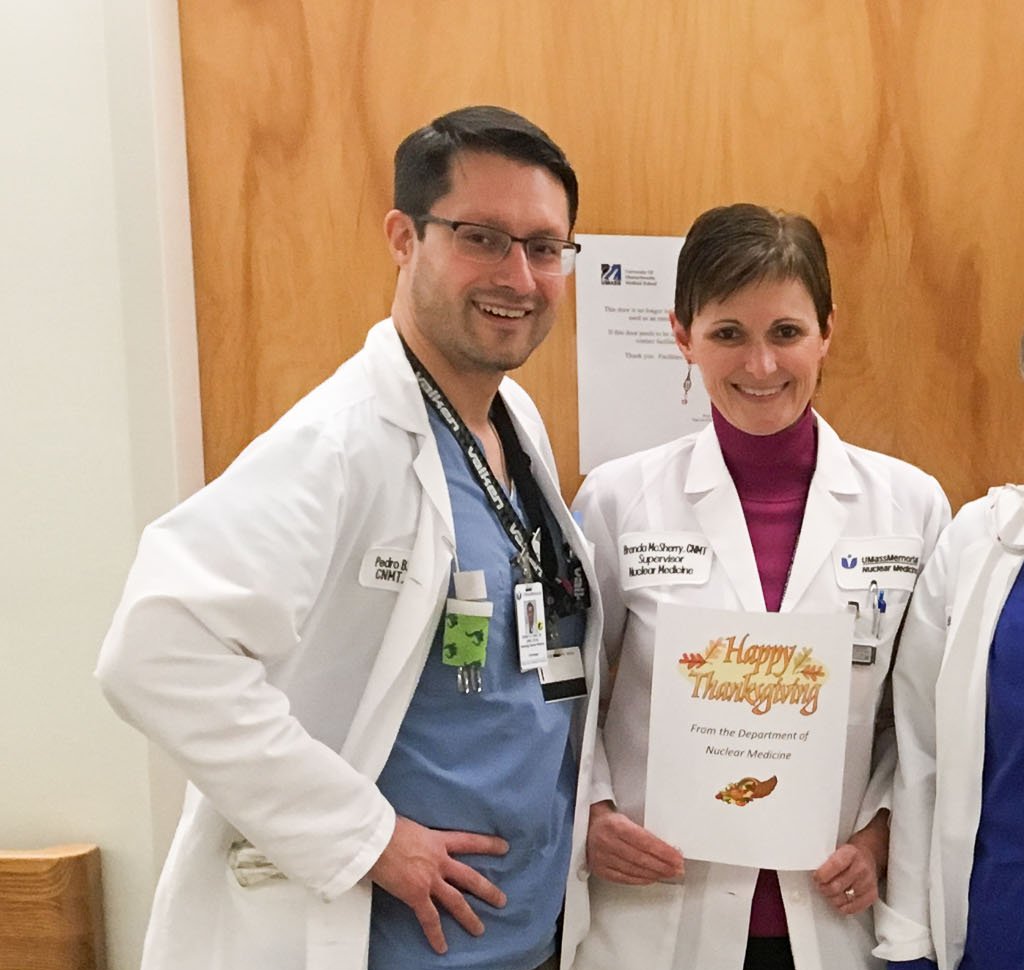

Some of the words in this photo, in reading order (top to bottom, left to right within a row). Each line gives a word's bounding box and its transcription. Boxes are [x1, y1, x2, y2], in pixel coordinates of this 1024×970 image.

[466, 446, 504, 511] valken
[623, 543, 648, 555] Brenda
[375, 556, 400, 570] Pedro
[638, 554, 684, 565] Supervisor
[628, 565, 656, 577] Nuclear
[657, 564, 694, 575] Medicine
[862, 565, 892, 573] Nuclear
[723, 633, 797, 677] Happy
[688, 670, 822, 716] Thanksgiving
[690, 723, 716, 735] From
[718, 727, 736, 738] the
[738, 729, 797, 741] Department
[799, 731, 810, 742] of
[705, 745, 744, 757] Nuclear
[747, 749, 792, 760] Medicine
